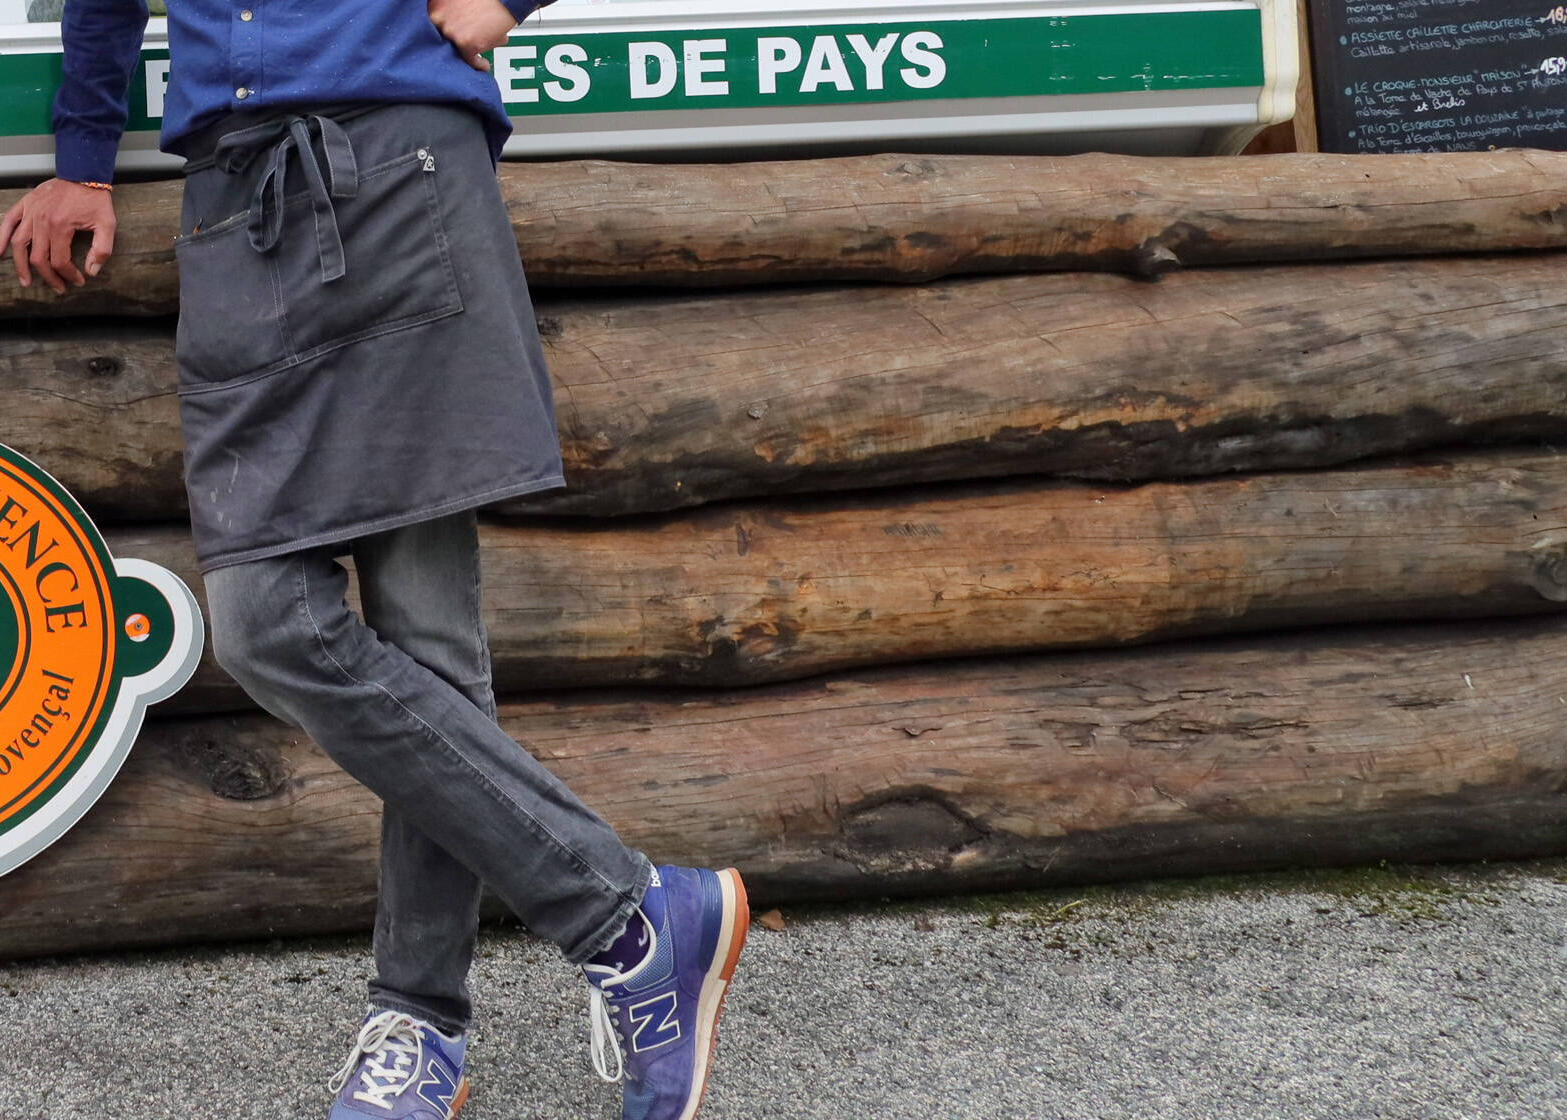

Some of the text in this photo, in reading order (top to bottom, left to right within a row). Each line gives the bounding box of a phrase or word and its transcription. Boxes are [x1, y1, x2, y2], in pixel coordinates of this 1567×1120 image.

[1351, 29, 1405, 44] ASSIETTE
[628, 39, 729, 100] DE
[758, 31, 947, 93] PAYS
[1354, 81, 1369, 94] LE
[1540, 56, 1567, 75] 15,9
